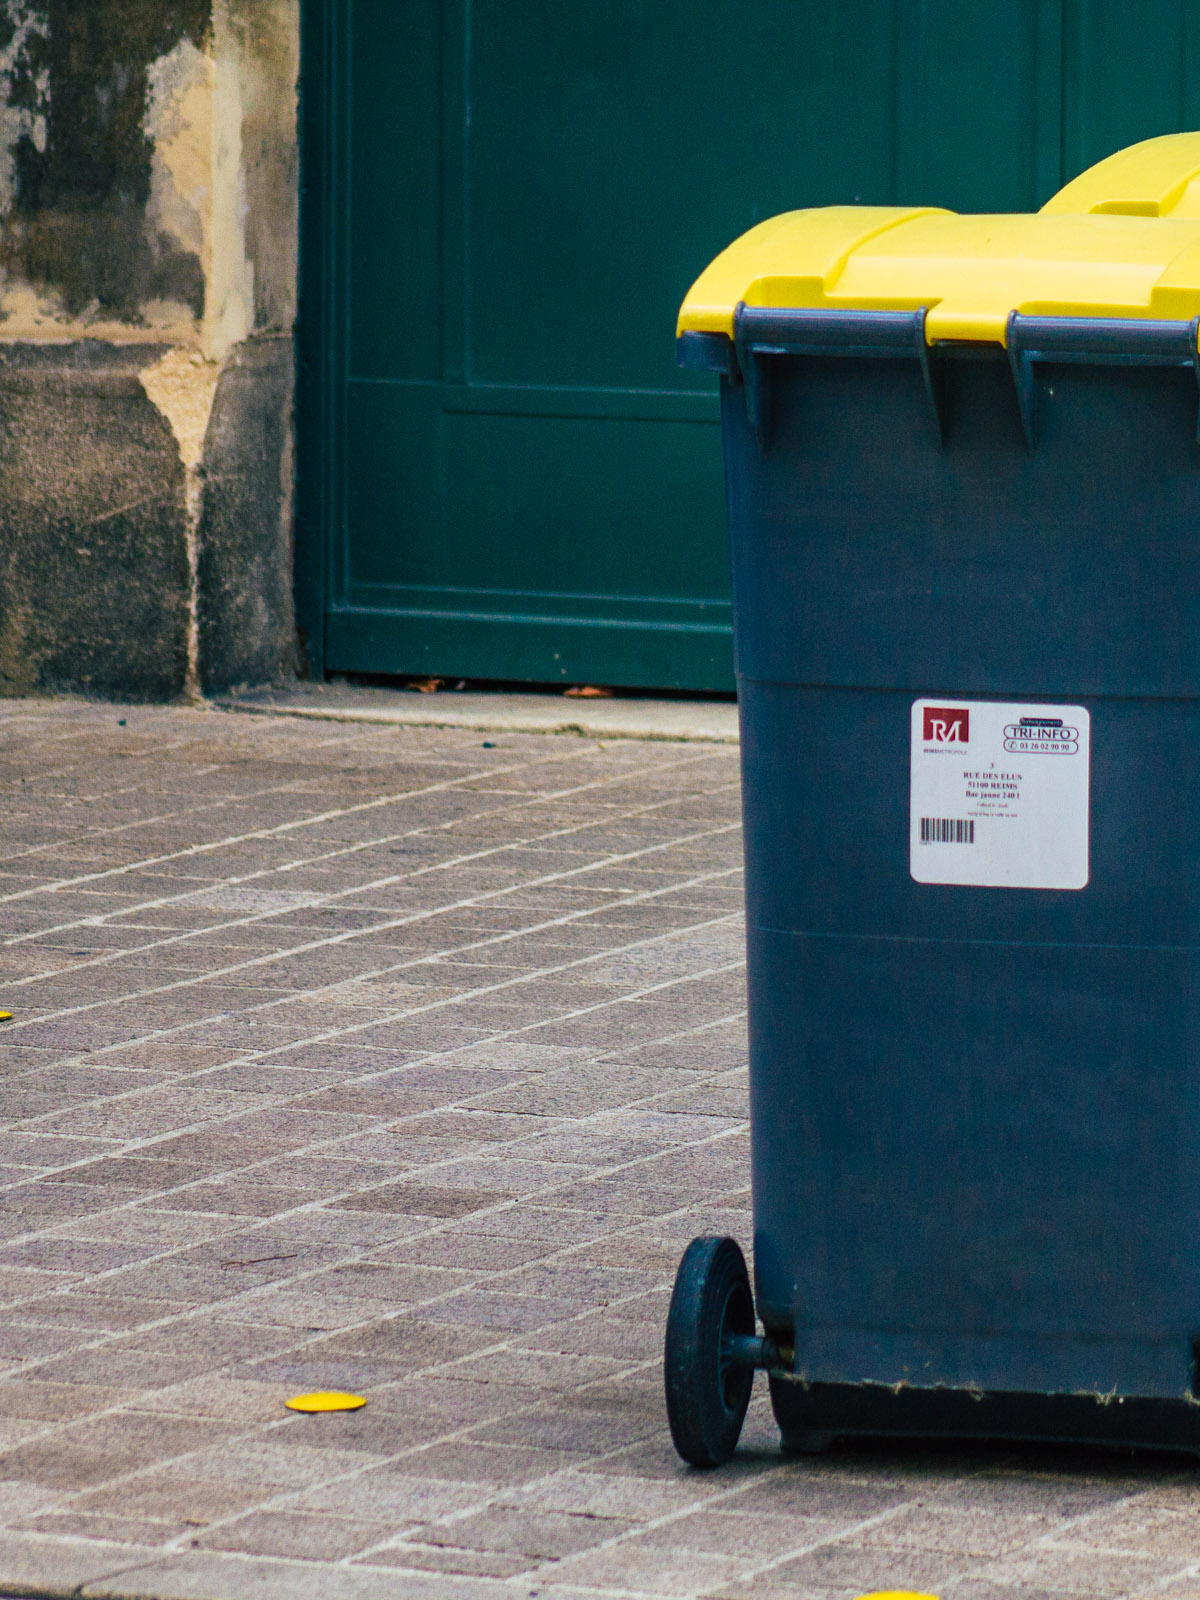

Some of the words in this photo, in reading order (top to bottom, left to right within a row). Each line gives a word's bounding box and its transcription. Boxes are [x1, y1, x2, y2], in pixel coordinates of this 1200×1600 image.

[1010, 728, 1070, 739] TRI-INFO
[1020, 742, 1028, 750] 03
[1030, 742, 1039, 750] 26
[1040, 742, 1049, 751] 02
[1050, 743, 1059, 751] 90
[1060, 743, 1070, 751] 90
[963, 771, 980, 779] RUE
[982, 772, 999, 780] DES
[990, 782, 1018, 790] REIMS
